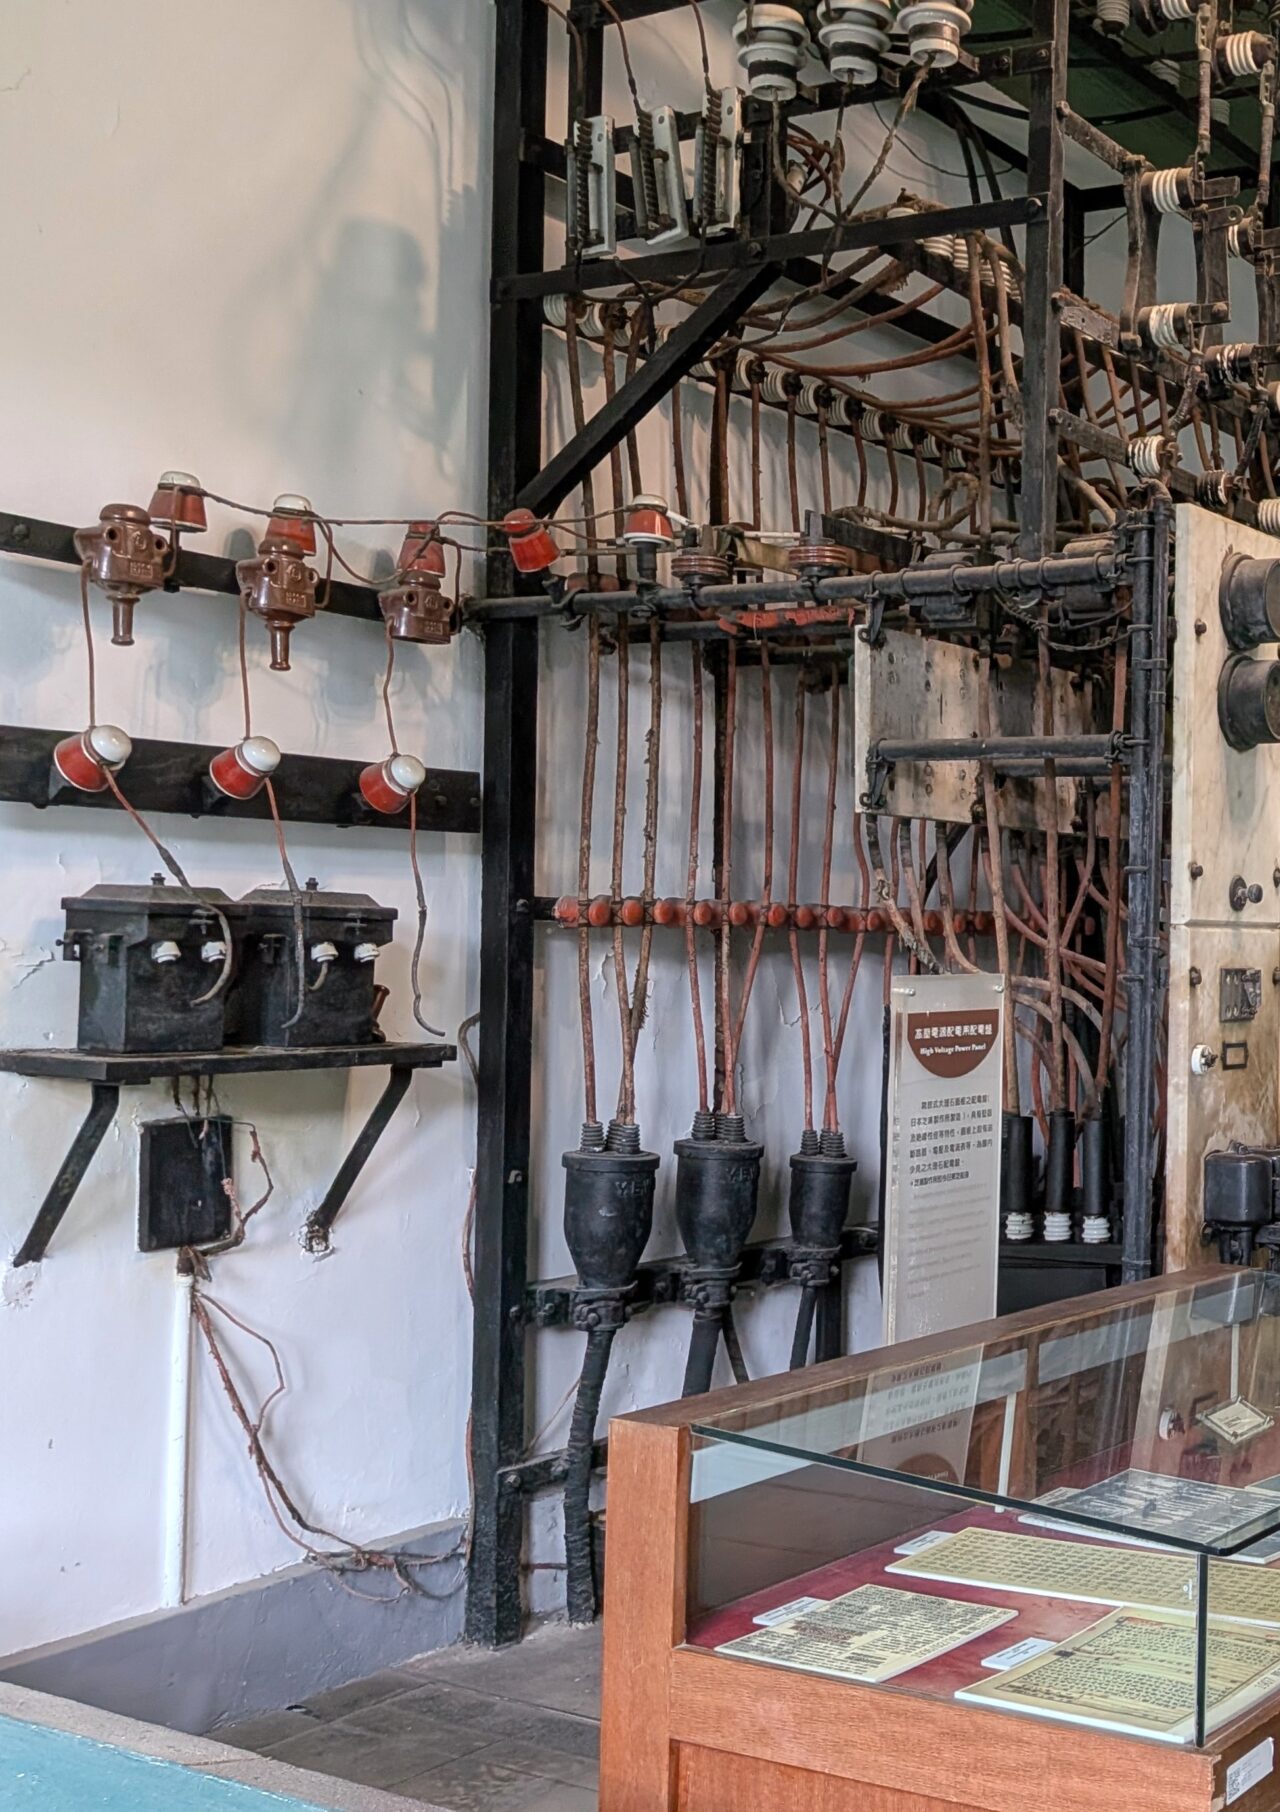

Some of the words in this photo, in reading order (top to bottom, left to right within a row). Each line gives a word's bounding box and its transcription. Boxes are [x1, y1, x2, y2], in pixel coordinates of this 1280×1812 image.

[920, 1047, 934, 1056] High
[934, 1046, 954, 1055] Voltage
[972, 1043, 986, 1051] Panel
